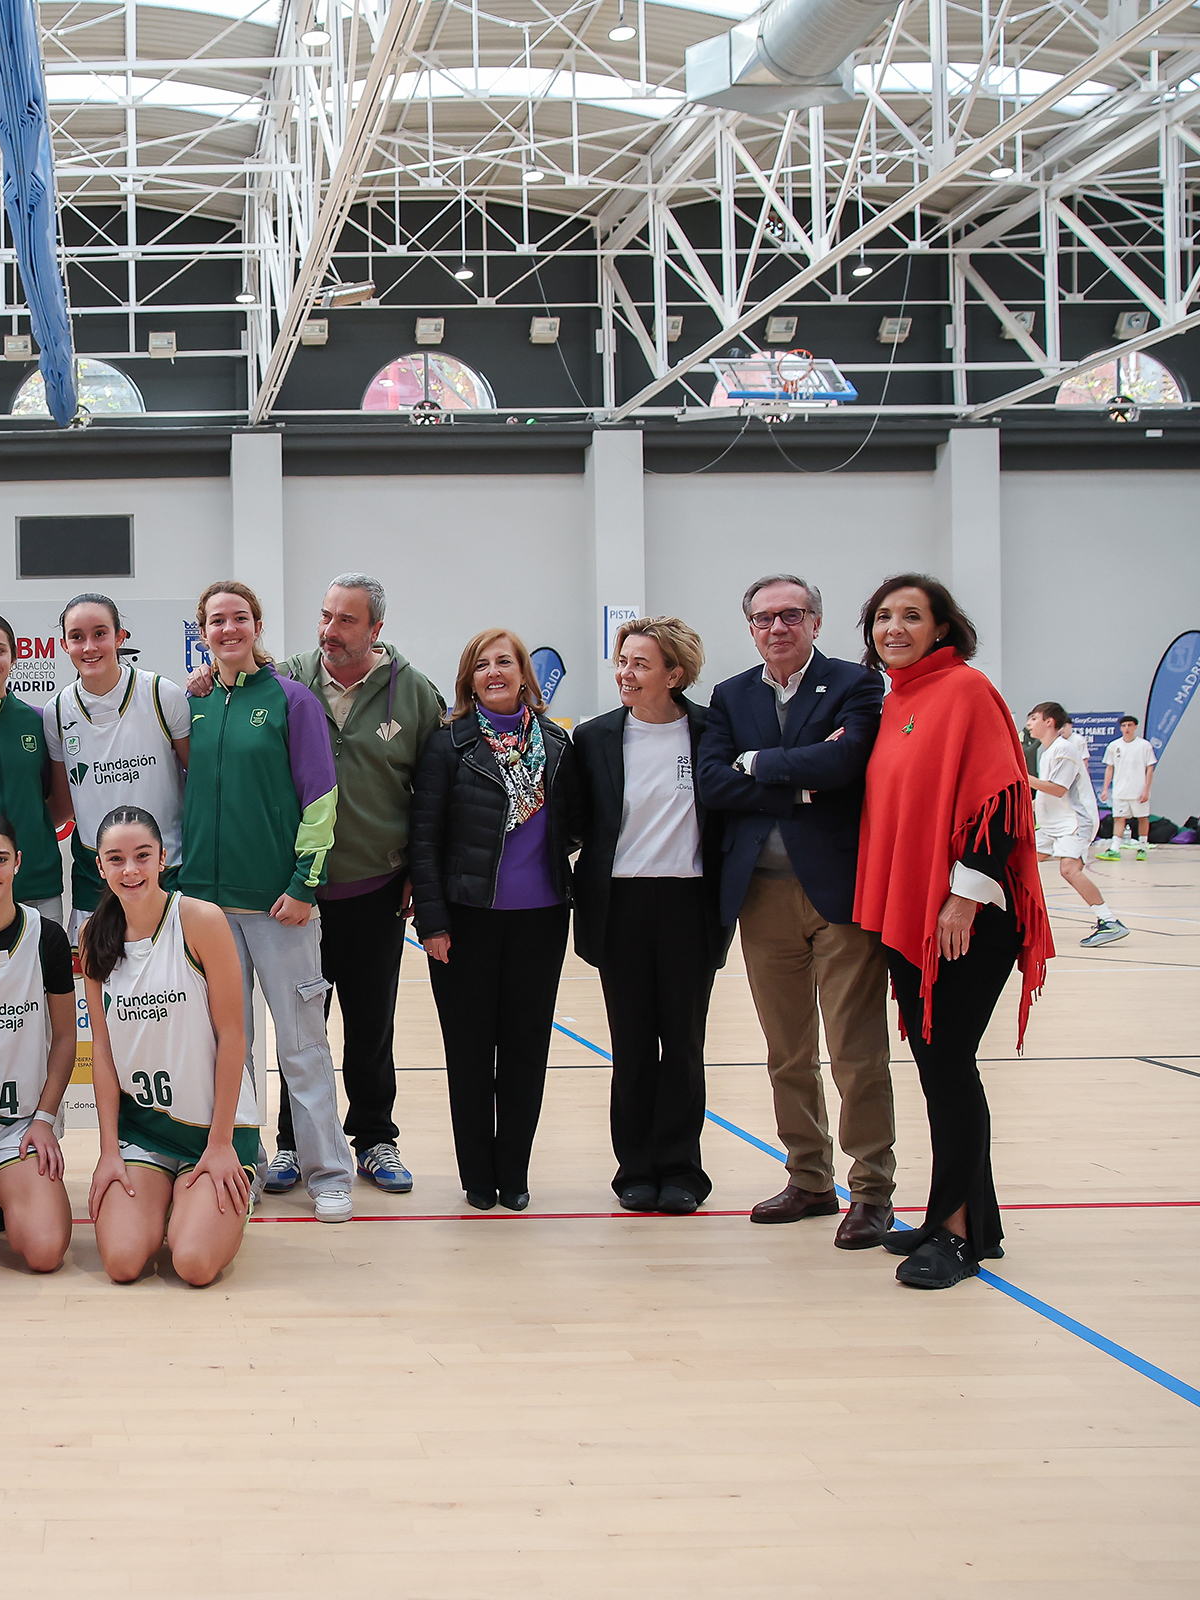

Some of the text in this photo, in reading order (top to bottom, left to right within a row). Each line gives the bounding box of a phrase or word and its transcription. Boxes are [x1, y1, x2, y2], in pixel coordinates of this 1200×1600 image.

[610, 610, 637, 619] PISTA
[17, 637, 55, 658] BM
[11, 660, 56, 670] DERACIÓN
[541, 668, 561, 703] DRID
[1173, 656, 1200, 704] MADRI
[1085, 727, 1106, 735] MAKE
[1107, 727, 1115, 735] IT
[93, 754, 157, 773] Fundación
[94, 769, 140, 785] Unicaja
[116, 990, 187, 1008] Fundación
[116, 1006, 168, 1022] Unicaja
[131, 1070, 173, 1108] 36
